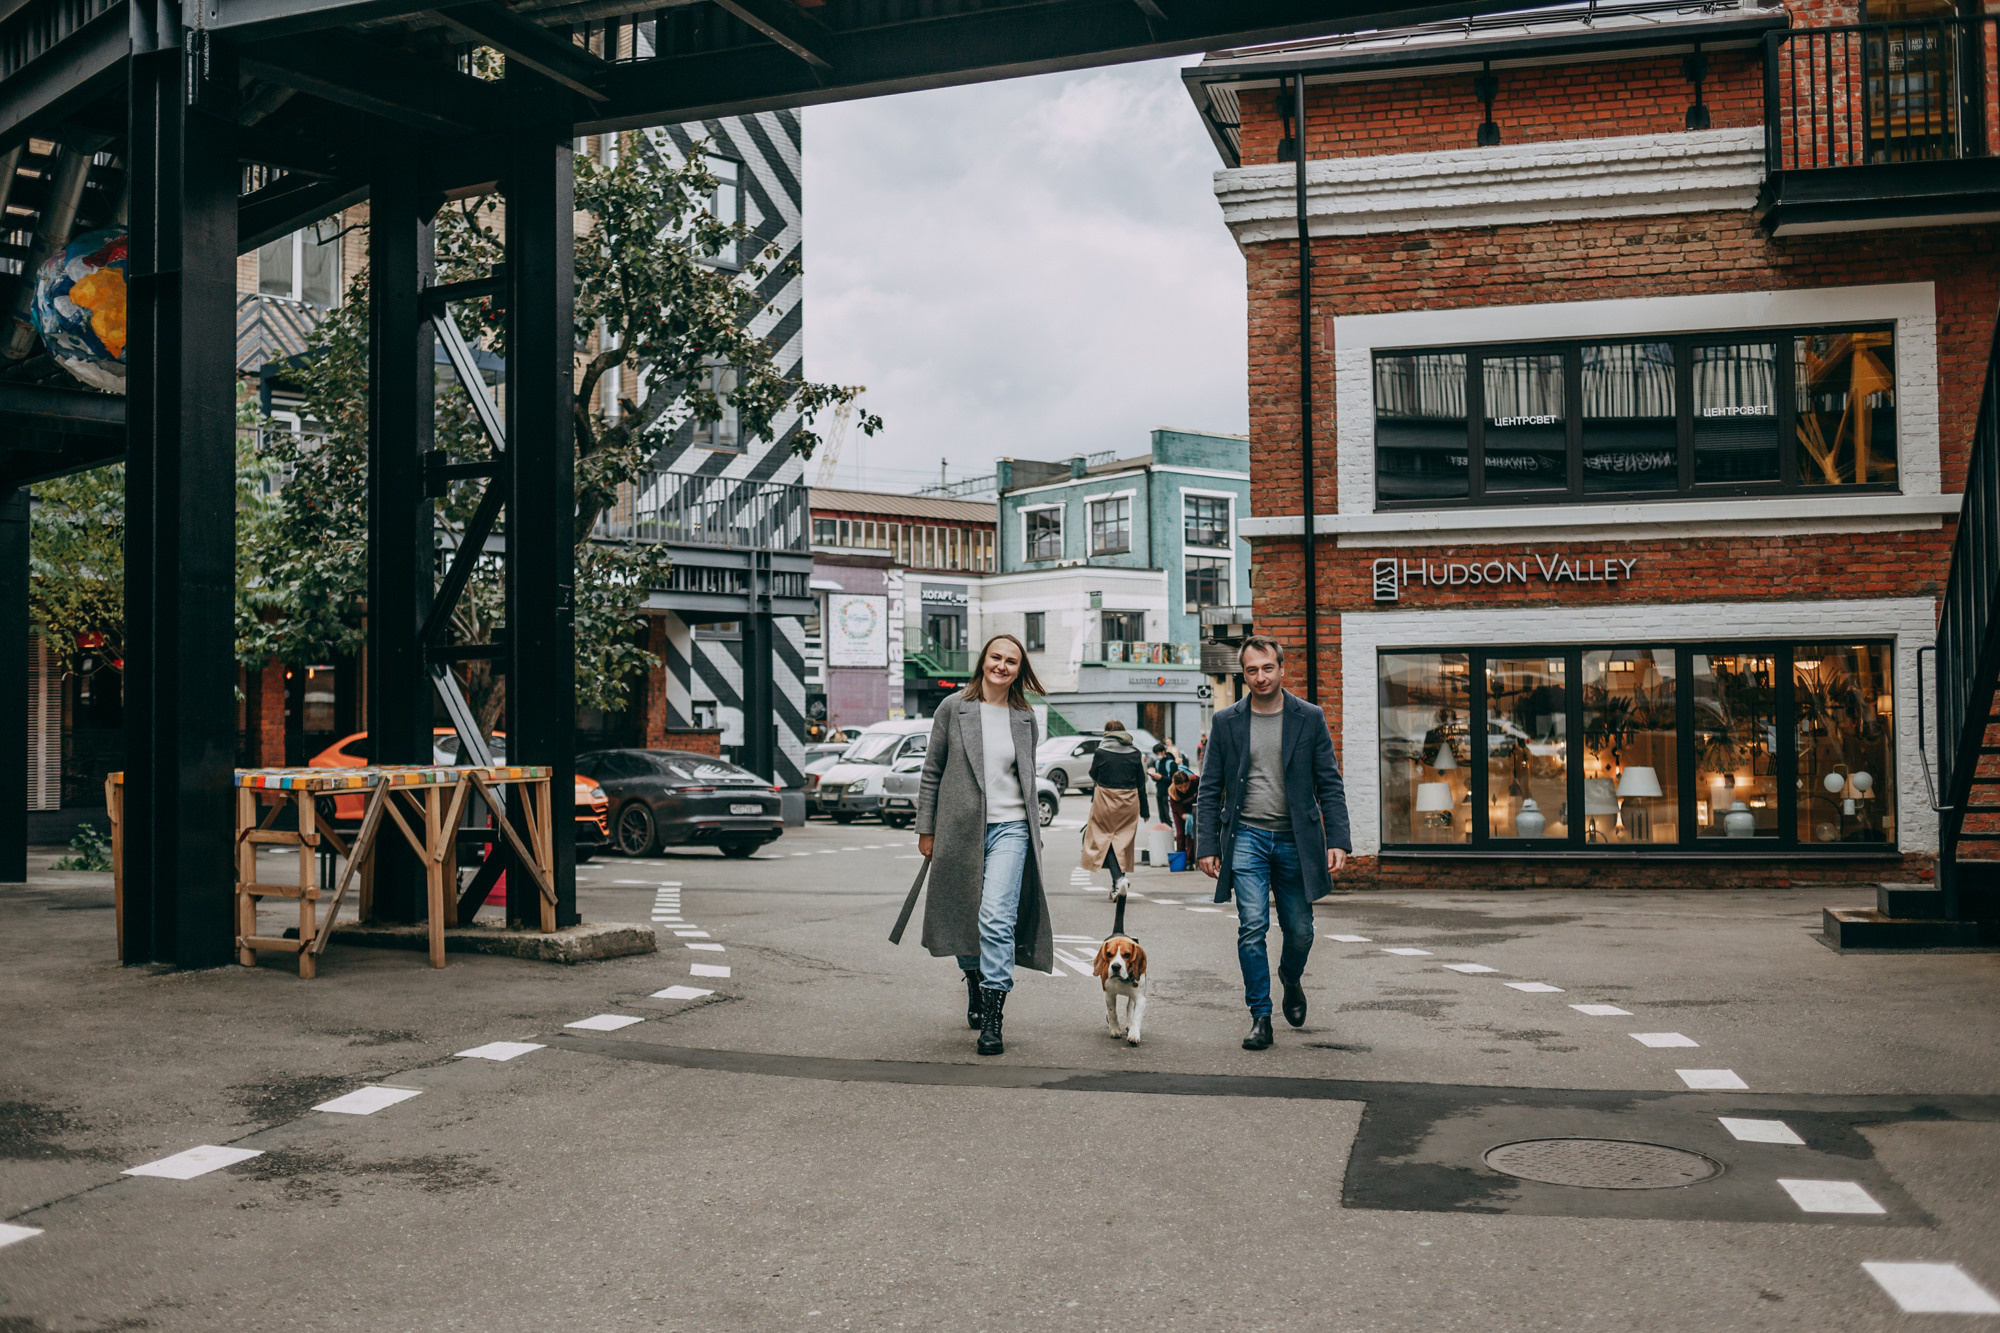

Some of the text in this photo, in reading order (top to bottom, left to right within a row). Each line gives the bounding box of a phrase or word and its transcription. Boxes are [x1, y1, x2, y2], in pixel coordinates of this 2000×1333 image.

[1703, 405, 1768, 417] ЦЕНТРСВЕТ
[1494, 414, 1557, 427] ЦЕНТРСВЕТ
[1402, 553, 1638, 586] HUDSON VALLEY
